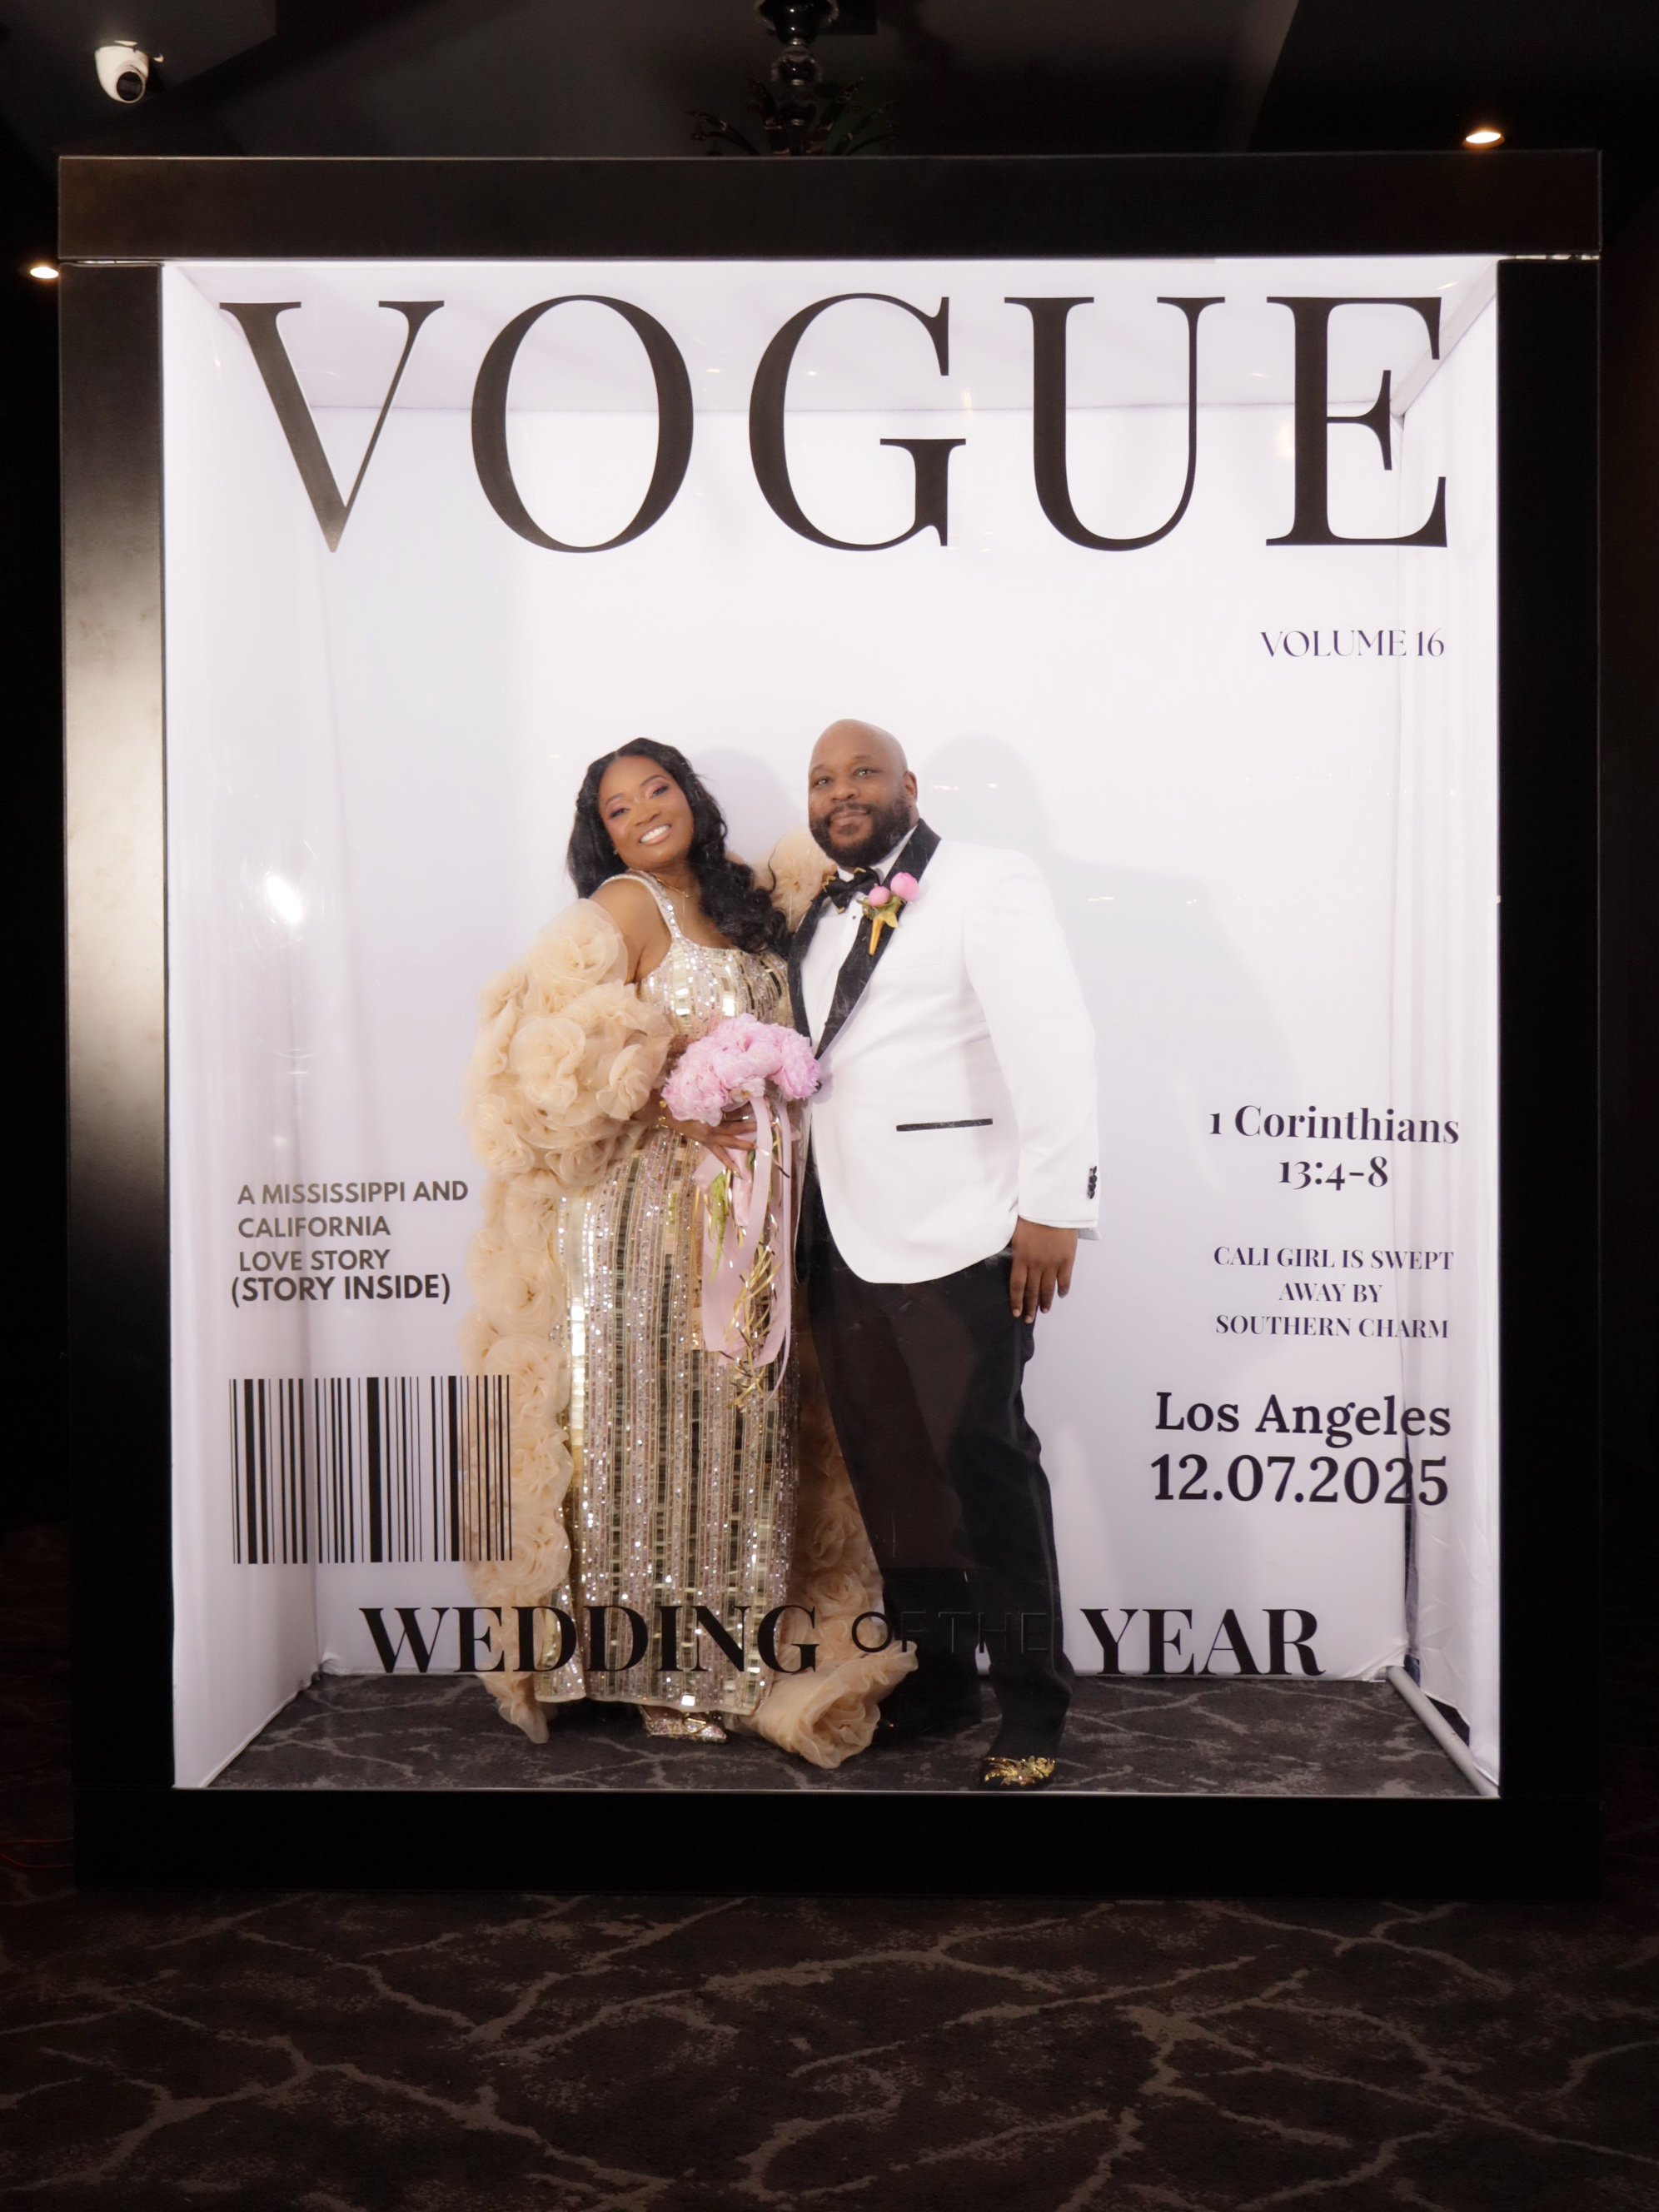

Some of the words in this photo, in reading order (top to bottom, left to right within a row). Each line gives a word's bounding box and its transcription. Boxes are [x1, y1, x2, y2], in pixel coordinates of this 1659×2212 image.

[219, 292, 1447, 553] VOGUE
[1260, 630, 1407, 657] VOLUME
[1416, 629, 1444, 657] 16
[1209, 1112, 1221, 1135] 1
[1234, 1105, 1459, 1144] Corinthians
[1278, 1156, 1388, 1190] 13:4-8
[237, 1185, 255, 1204] A
[262, 1182, 405, 1203] MISSISSIPPI
[413, 1180, 468, 1201] AND
[238, 1216, 391, 1238] CALIFORNIA
[240, 1251, 302, 1272] LOVE
[311, 1249, 390, 1270] STORY
[1213, 1247, 1269, 1266] CALI
[1277, 1248, 1334, 1268] GIRL
[1343, 1250, 1363, 1269] IS
[1372, 1250, 1454, 1270] SWEPT
[232, 1276, 336, 1308] (STORY
[345, 1273, 451, 1304] INSIDE)
[1278, 1283, 1345, 1302] AWAY
[1353, 1284, 1382, 1303] BY
[1216, 1315, 1351, 1337] SOUTHERN
[1358, 1318, 1448, 1338] CHARM
[1155, 1392, 1239, 1432] Los
[1256, 1394, 1451, 1448] Angeles
[1150, 1454, 1447, 1506] 12.07.2025
[359, 1605, 820, 1673] WEDDING
[852, 1611, 928, 1653] OF
[939, 1612, 1049, 1654] THE
[1080, 1608, 1326, 1676] YEAR
